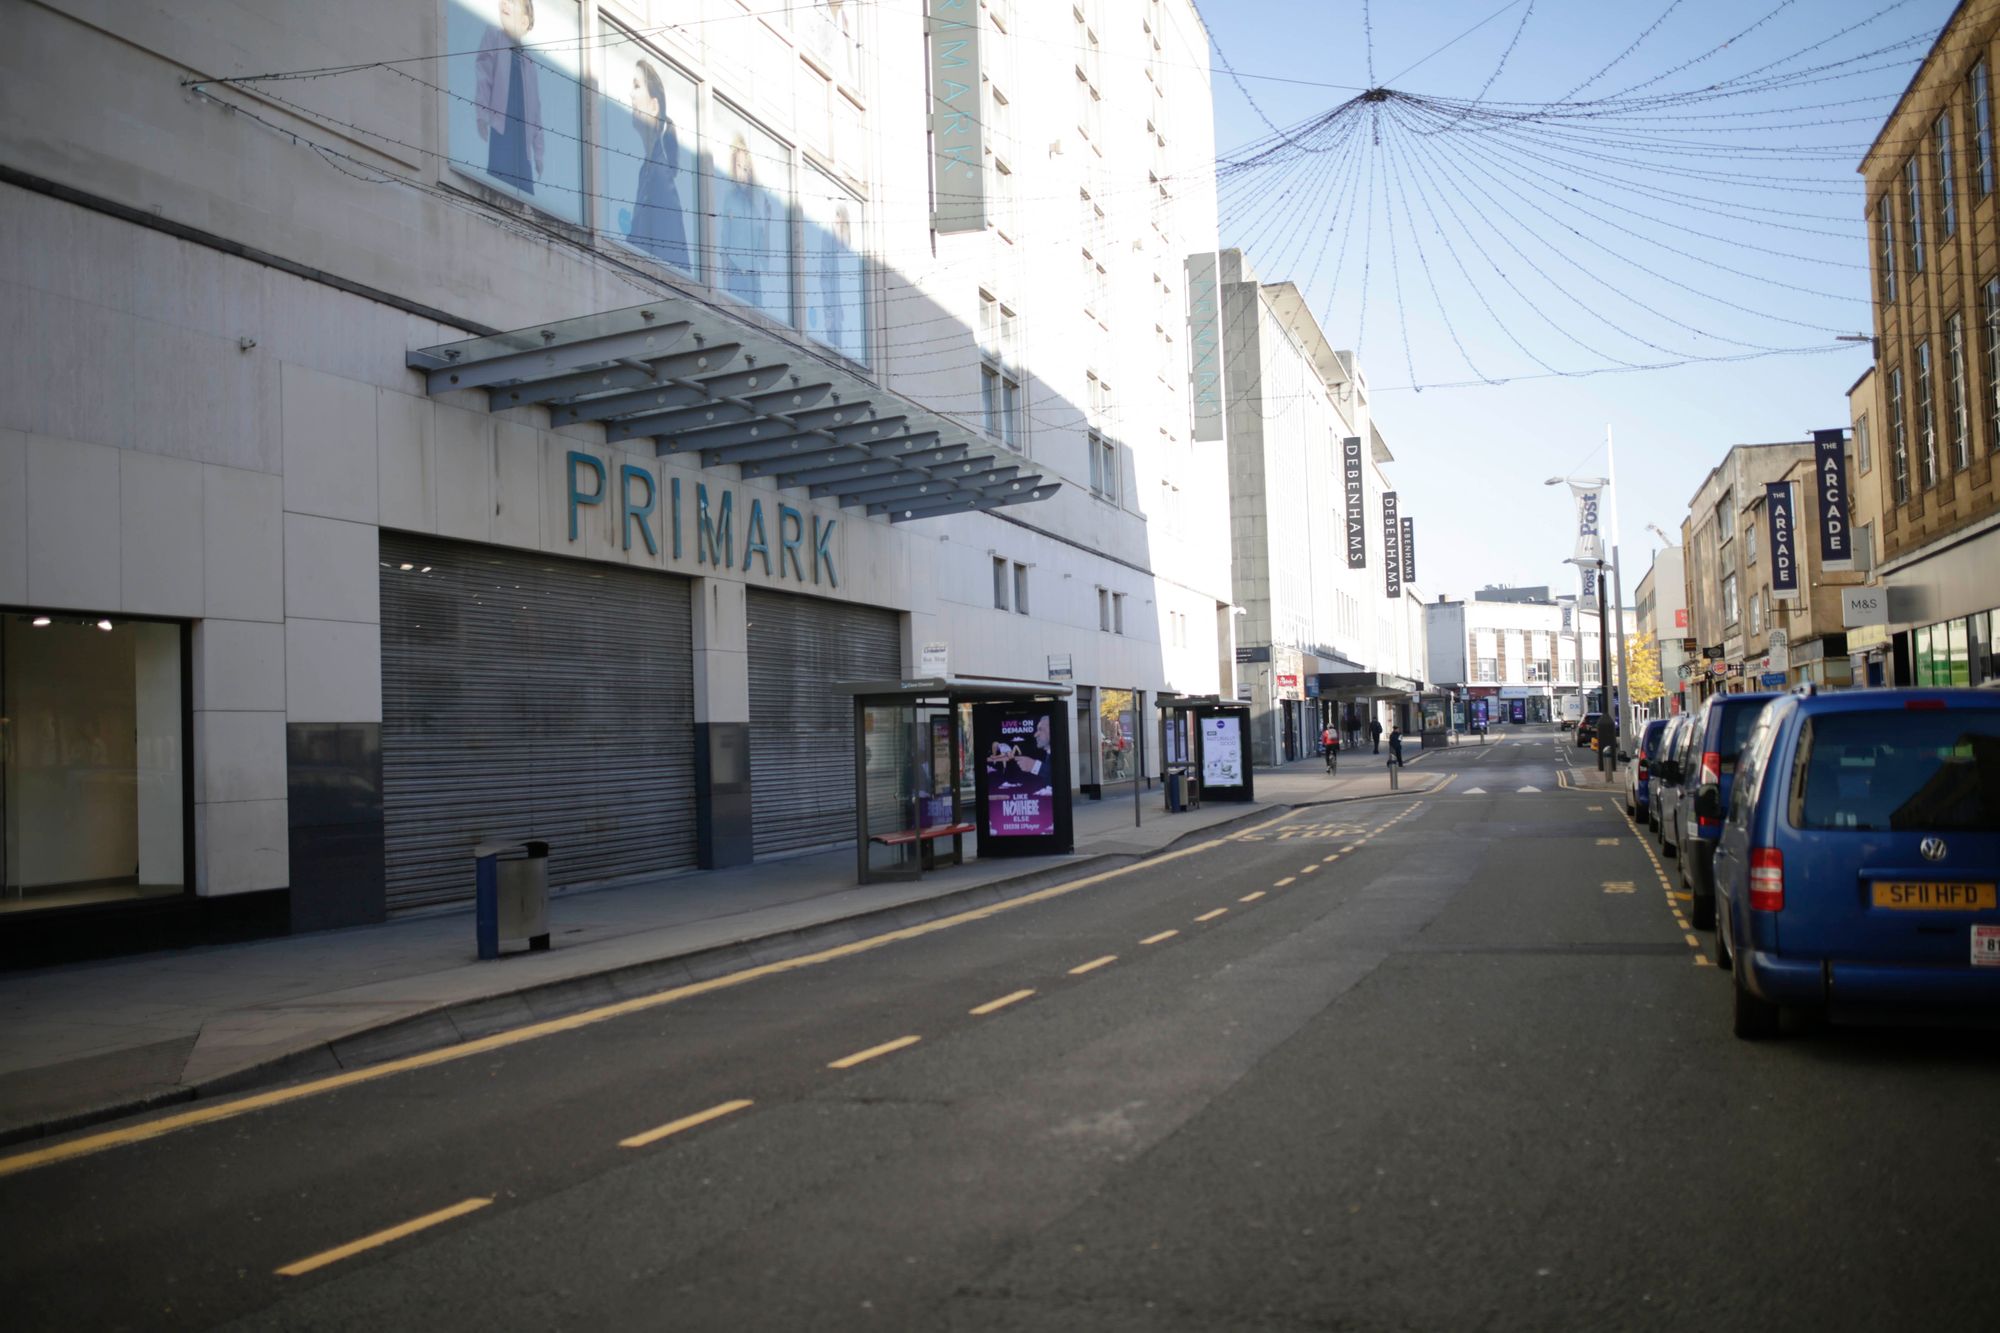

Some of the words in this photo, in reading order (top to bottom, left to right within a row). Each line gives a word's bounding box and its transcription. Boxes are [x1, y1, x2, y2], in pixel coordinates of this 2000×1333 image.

[1194, 279, 1217, 407] PRIMARK
[1822, 442, 1838, 450] THE
[567, 450, 838, 588] PRIMARK
[1346, 445, 1363, 561] DEBENHAMS
[1580, 493, 1598, 536] Post
[1823, 457, 1842, 550] ARCADE
[1384, 498, 1399, 592] DEBENHAMS
[1403, 521, 1413, 580] DEBENHAMS
[1774, 505, 1790, 581] ARCADE
[1583, 569, 1595, 596] Post
[1851, 599, 1878, 609] M&S
[1001, 720, 1018, 728] LIVE
[1022, 719, 1034, 727] ON
[1890, 884, 1929, 903] SF11
[1936, 884, 1978, 903] HFD
